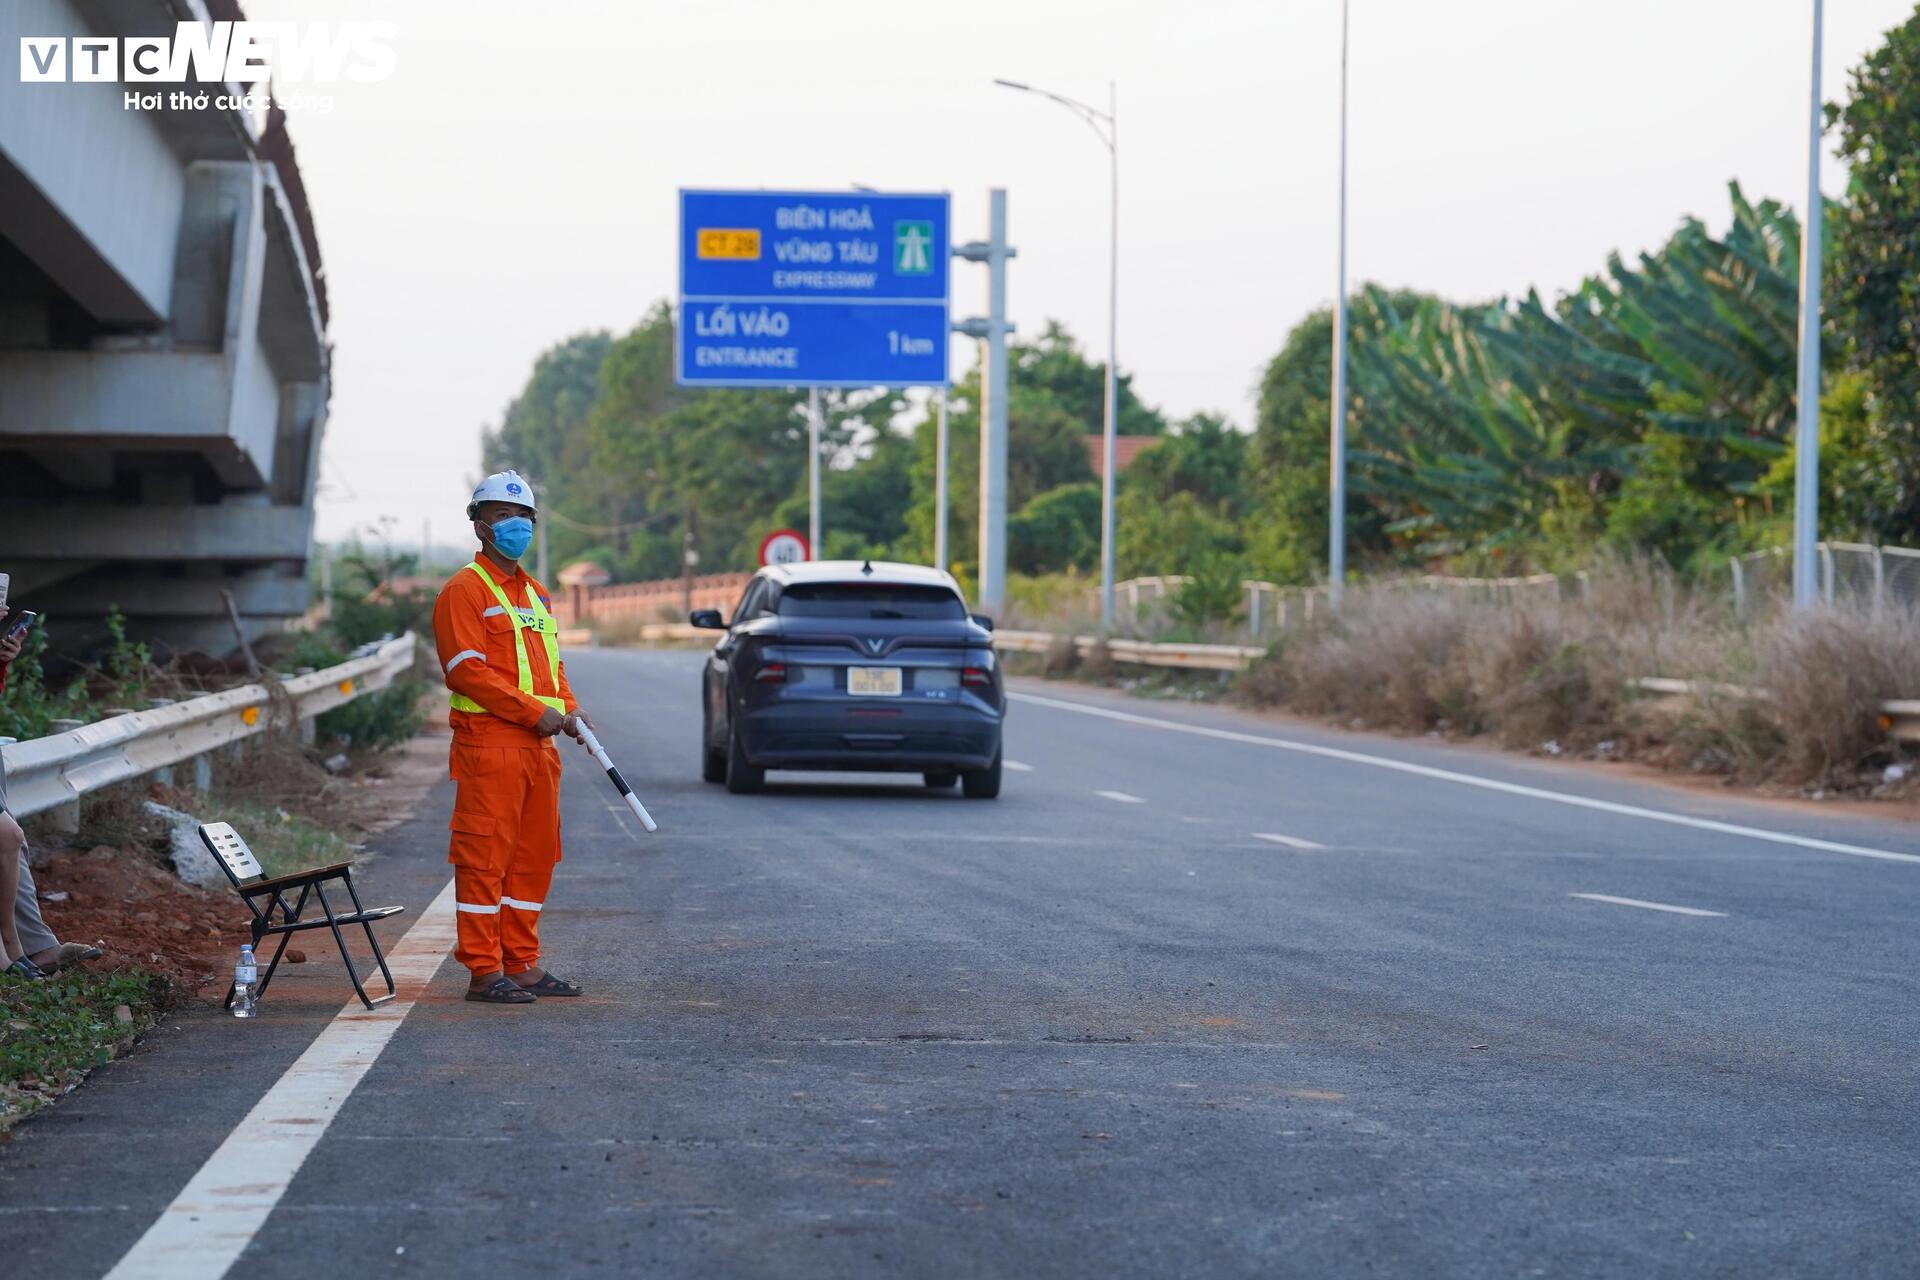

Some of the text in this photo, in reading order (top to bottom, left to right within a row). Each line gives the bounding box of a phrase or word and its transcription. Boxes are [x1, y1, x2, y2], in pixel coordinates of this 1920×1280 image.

[773, 271, 877, 288] EXPRESSWAY
[888, 330, 933, 355] 1 km
[695, 346, 797, 368] ENTRANCE
